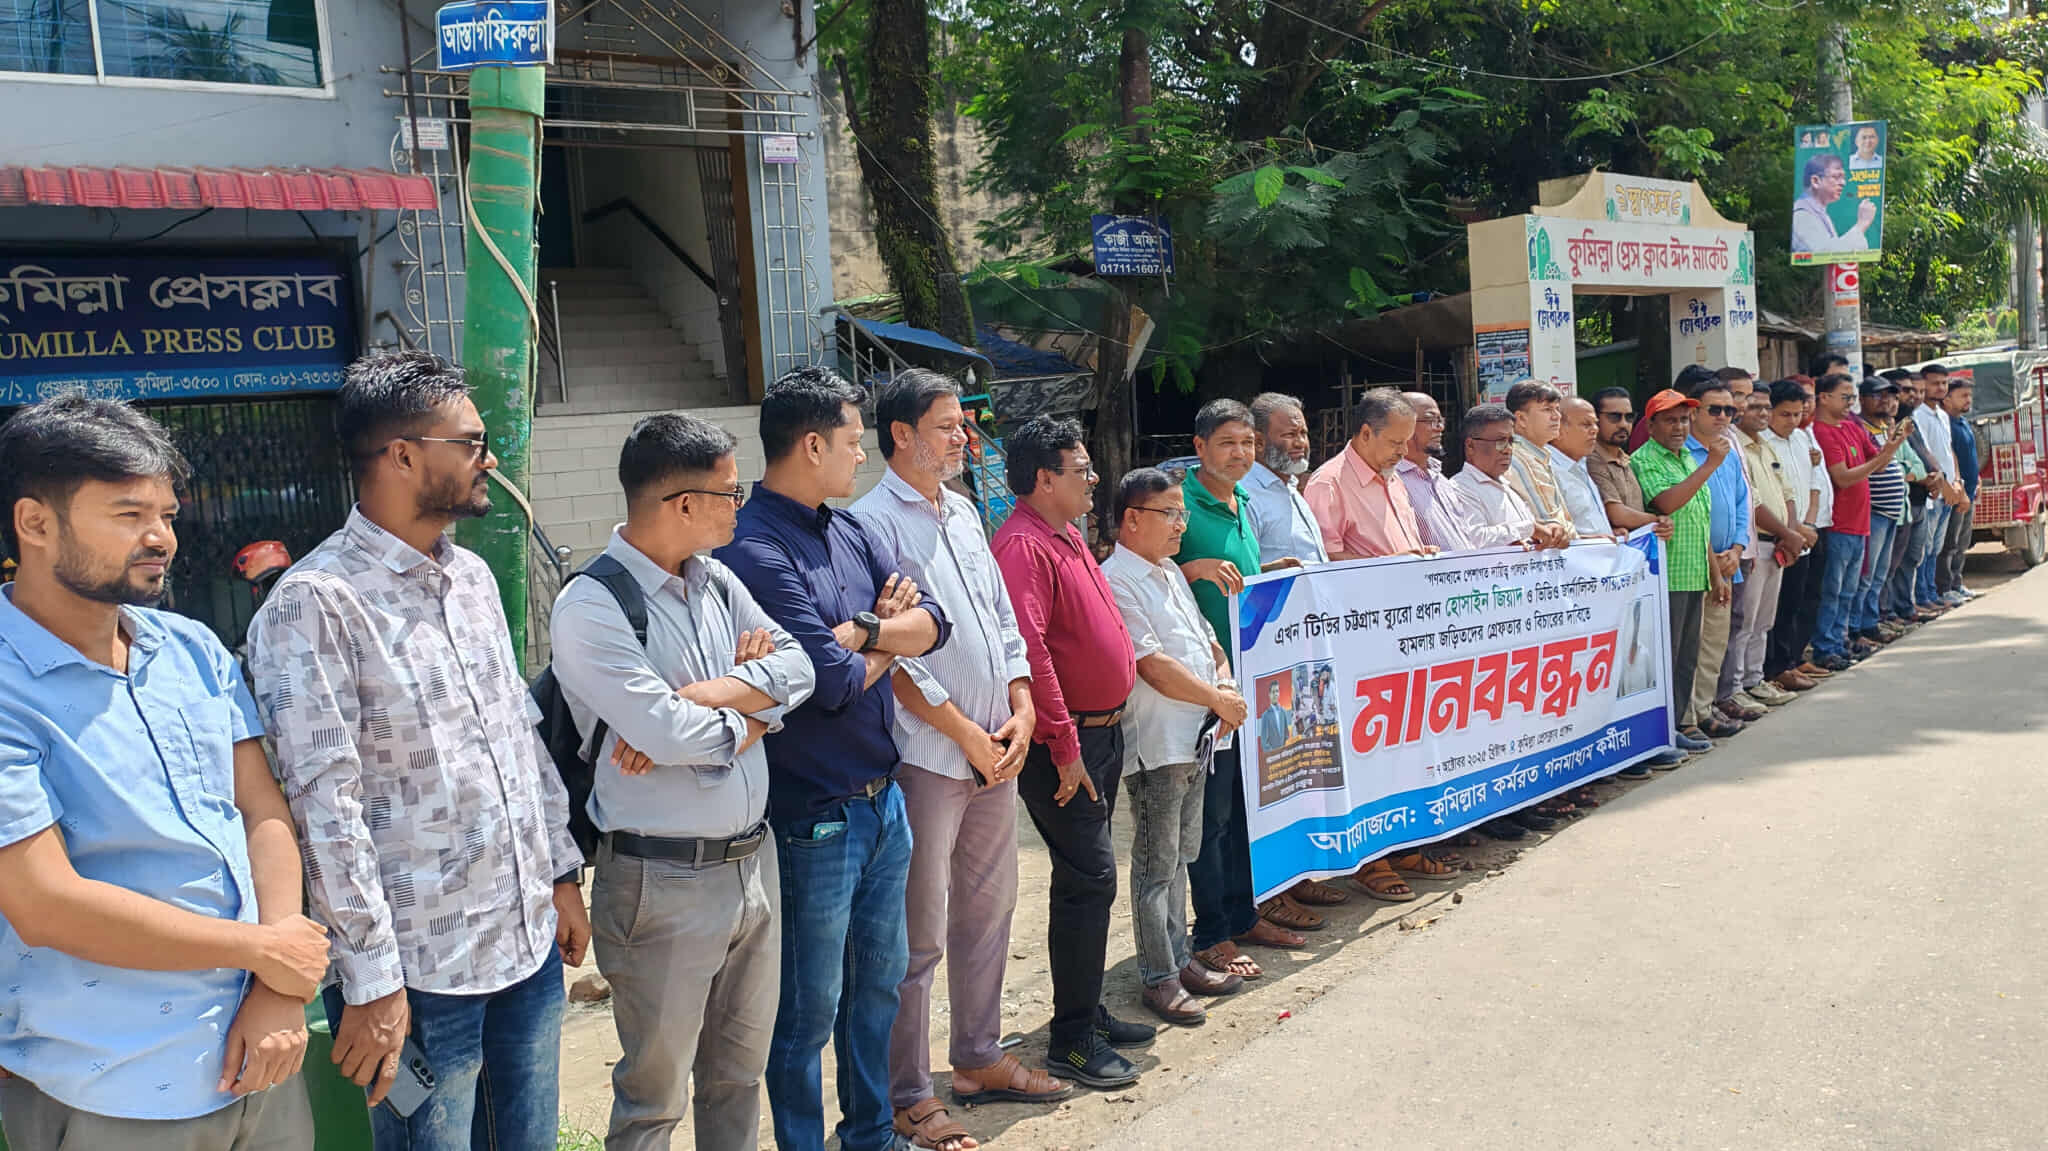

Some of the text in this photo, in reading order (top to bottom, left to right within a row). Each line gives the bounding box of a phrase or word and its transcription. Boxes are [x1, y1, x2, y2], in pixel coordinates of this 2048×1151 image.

[1100, 263, 1172, 274] 01711-16074
[1567, 228, 1729, 279] কুমিল্লা প্রেস ক্লাব ঈদ মার্কেট
[150, 273, 344, 310] প্রেসক্লাব
[141, 327, 243, 354] PRESS
[253, 325, 336, 350] CLUB
[1274, 621, 1300, 647] এখন
[1304, 612, 1341, 640] টিভির
[1344, 607, 1380, 632] চট্টগ্রাম
[1384, 605, 1412, 632] ব্যুরো
[1416, 600, 1441, 622] প্রধান
[1445, 588, 1489, 617] হোসাইন
[1492, 584, 1523, 611] জিয়াদ
[1526, 589, 1533, 604] ও
[1398, 605, 1591, 656] হামলায় জড়িতদের গ্রেফতার ও বিচারের দাবিতে
[1351, 629, 1618, 755] মানববন্ধন
[1306, 726, 1632, 855] আয়োজনে: কুমিল্লার কর্মরত গনমাধ্যম কর্মীরা
